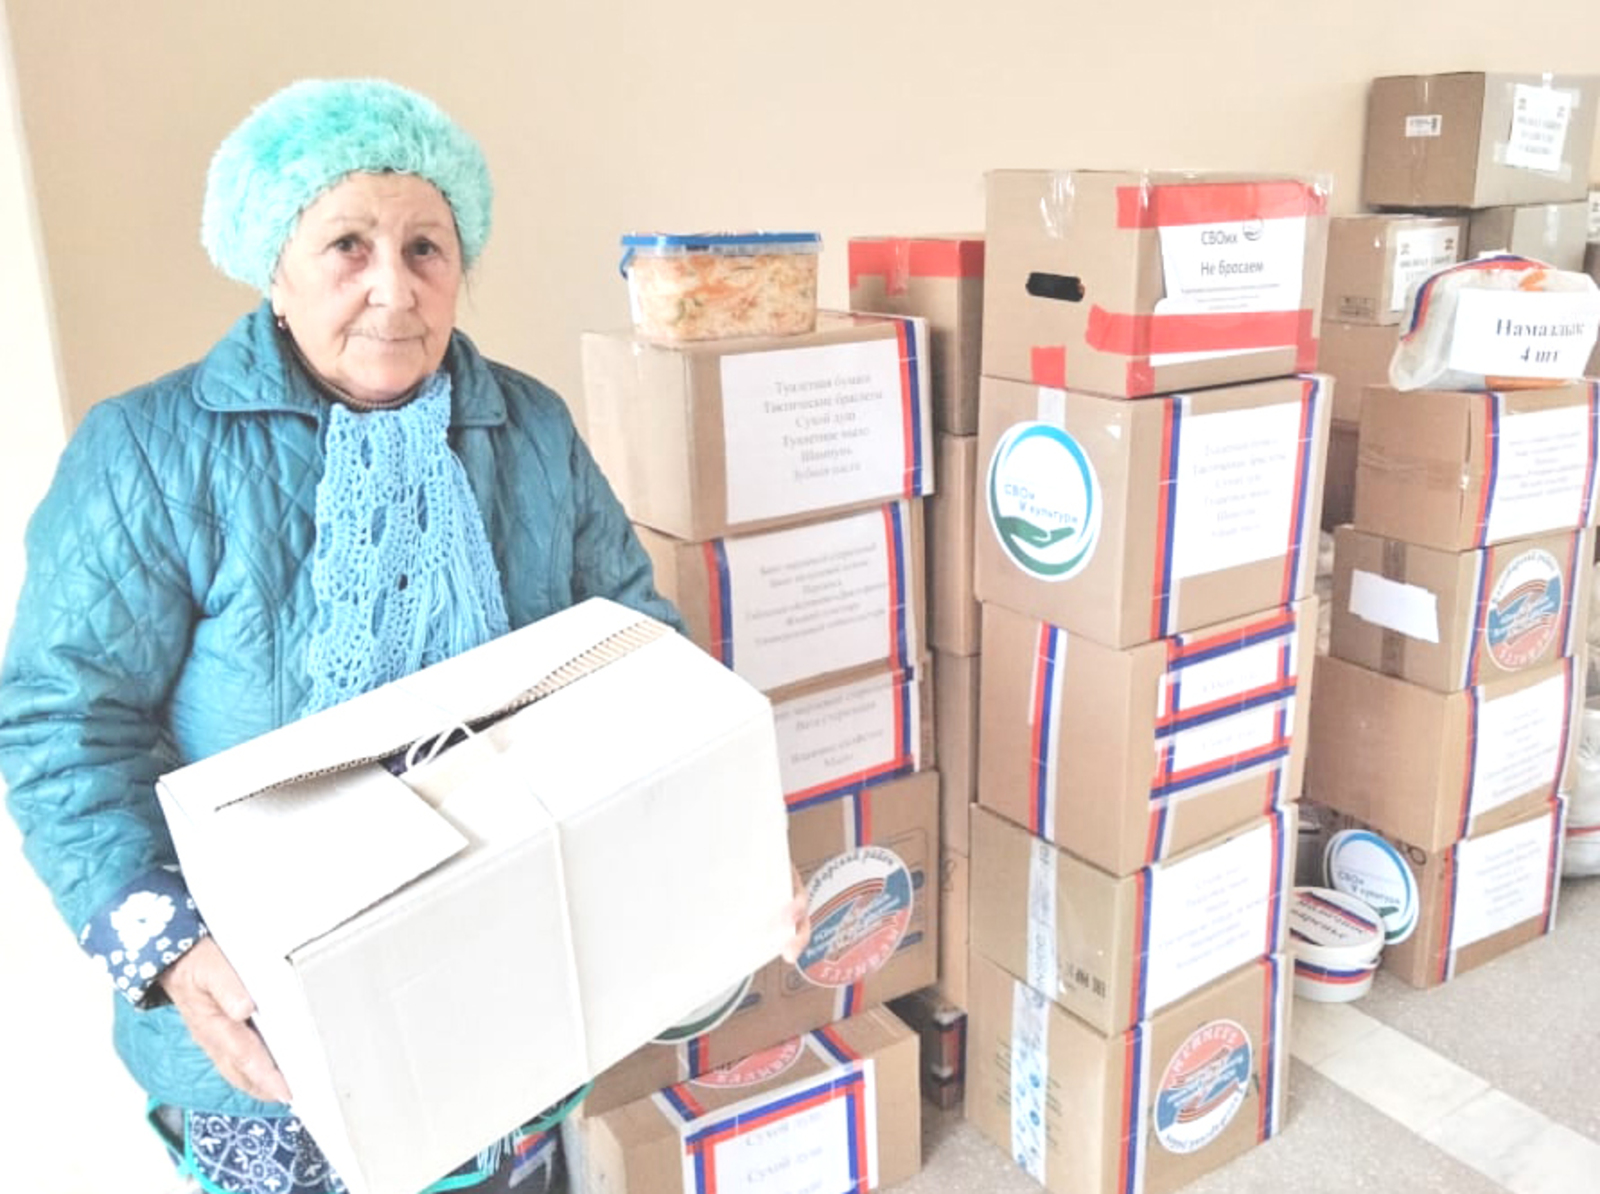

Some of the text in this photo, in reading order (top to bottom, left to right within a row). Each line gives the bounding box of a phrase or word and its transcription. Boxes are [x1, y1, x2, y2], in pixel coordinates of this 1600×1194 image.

[1201, 230, 1238, 245] СВОих
[1201, 259, 1264, 277] Не бросаем
[1520, 346, 1561, 363] 4 шт
